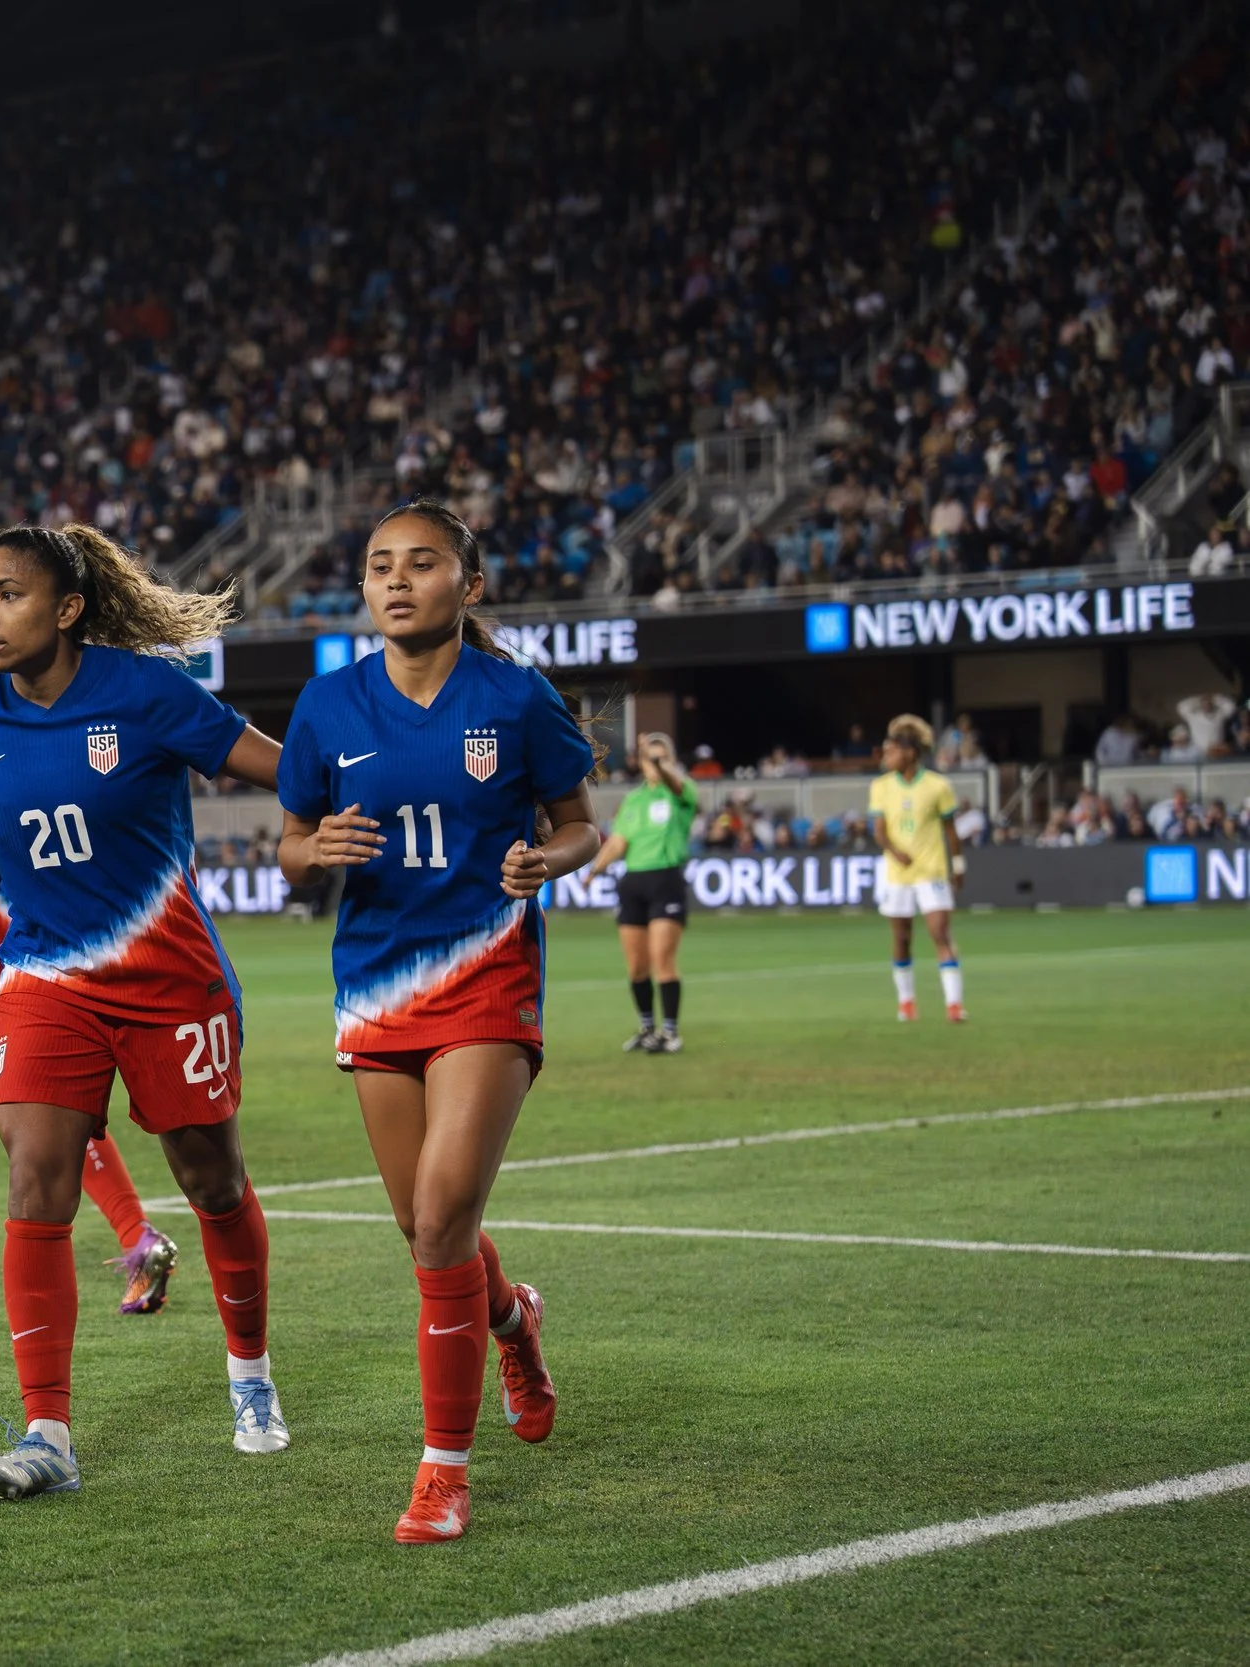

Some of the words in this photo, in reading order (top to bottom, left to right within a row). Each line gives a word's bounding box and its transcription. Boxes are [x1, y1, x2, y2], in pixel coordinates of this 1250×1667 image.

[854, 599, 957, 649] NEW
[961, 591, 1090, 641] YORK
[1095, 583, 1194, 634] LIFE
[553, 619, 638, 666] LIFE
[90, 735, 116, 751] USA
[467, 740, 494, 757] USA
[20, 804, 93, 869] 20
[396, 804, 447, 867] 11
[233, 866, 291, 912] LIF
[555, 860, 626, 908] NE
[175, 1013, 230, 1084] 20
